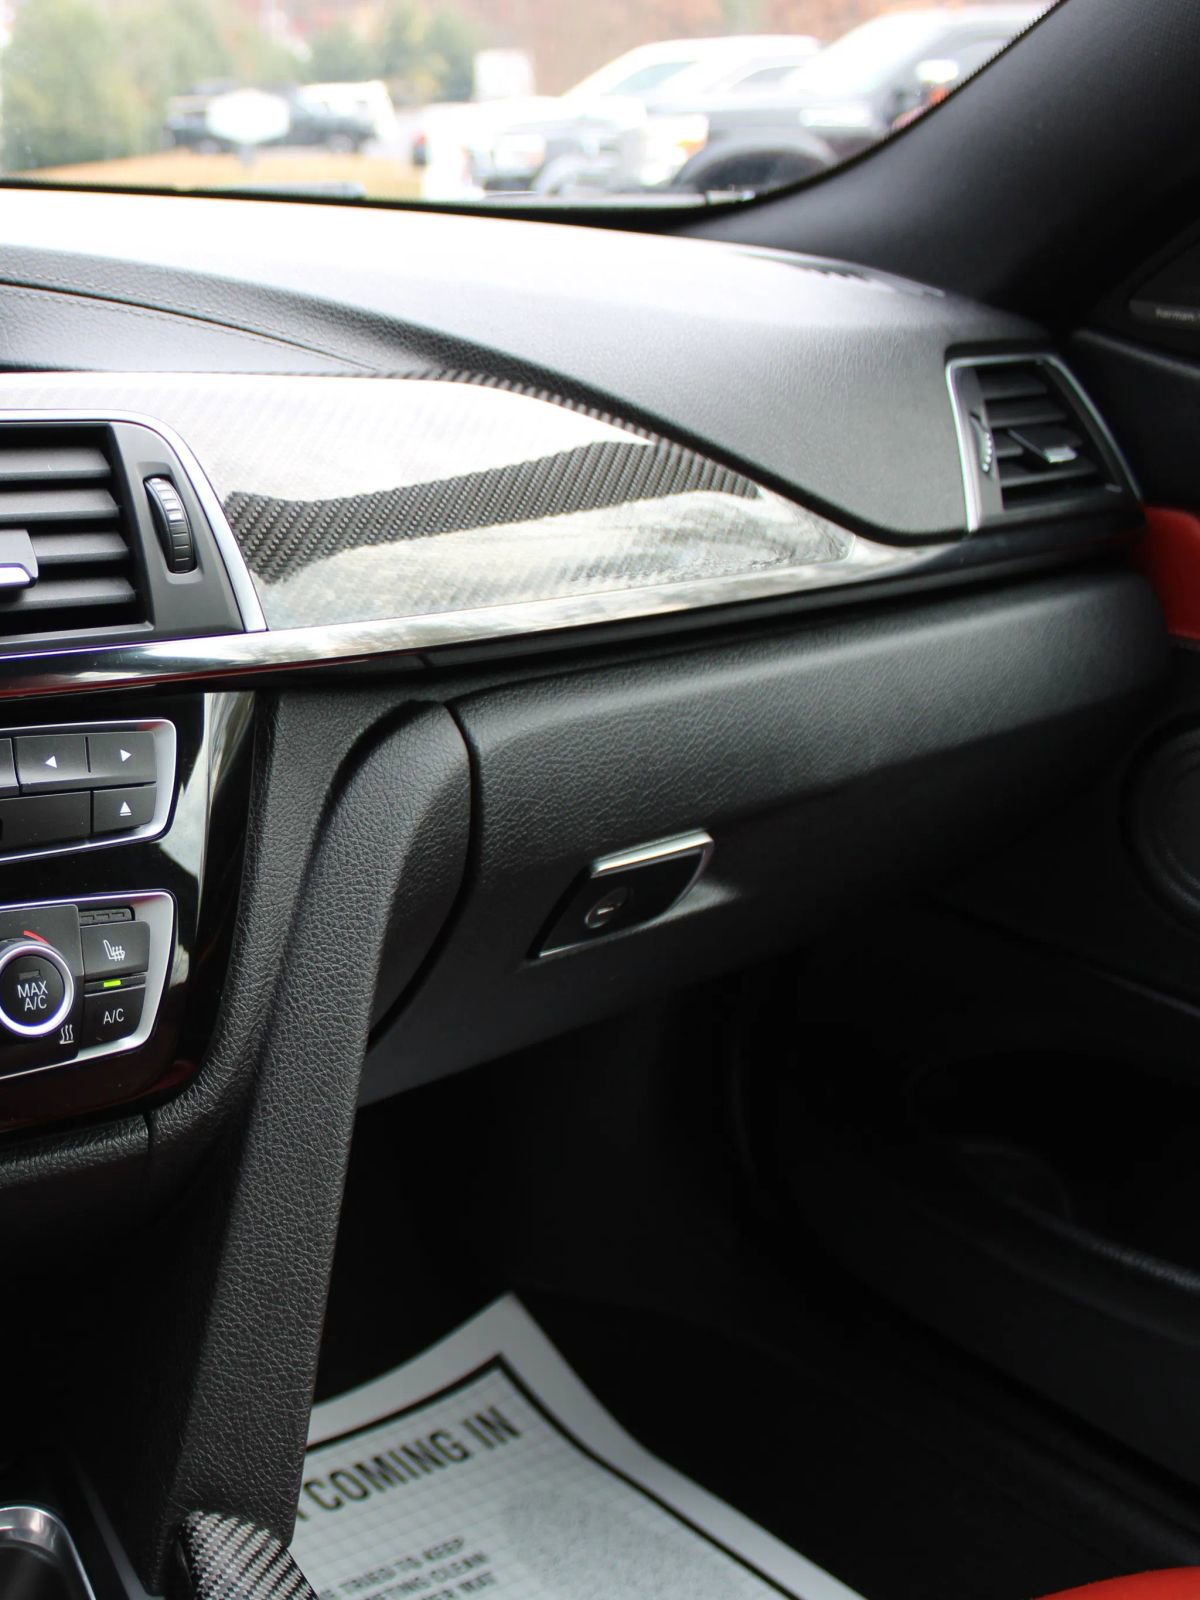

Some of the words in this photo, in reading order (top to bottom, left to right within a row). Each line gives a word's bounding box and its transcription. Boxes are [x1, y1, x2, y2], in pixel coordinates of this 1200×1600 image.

[16, 980, 49, 999] MAX
[23, 995, 48, 1012] A/C
[103, 1008, 125, 1025] A/C
[303, 1427, 471, 1510] COMING
[462, 1405, 521, 1449] IN
[422, 1536, 465, 1561] KEEP
